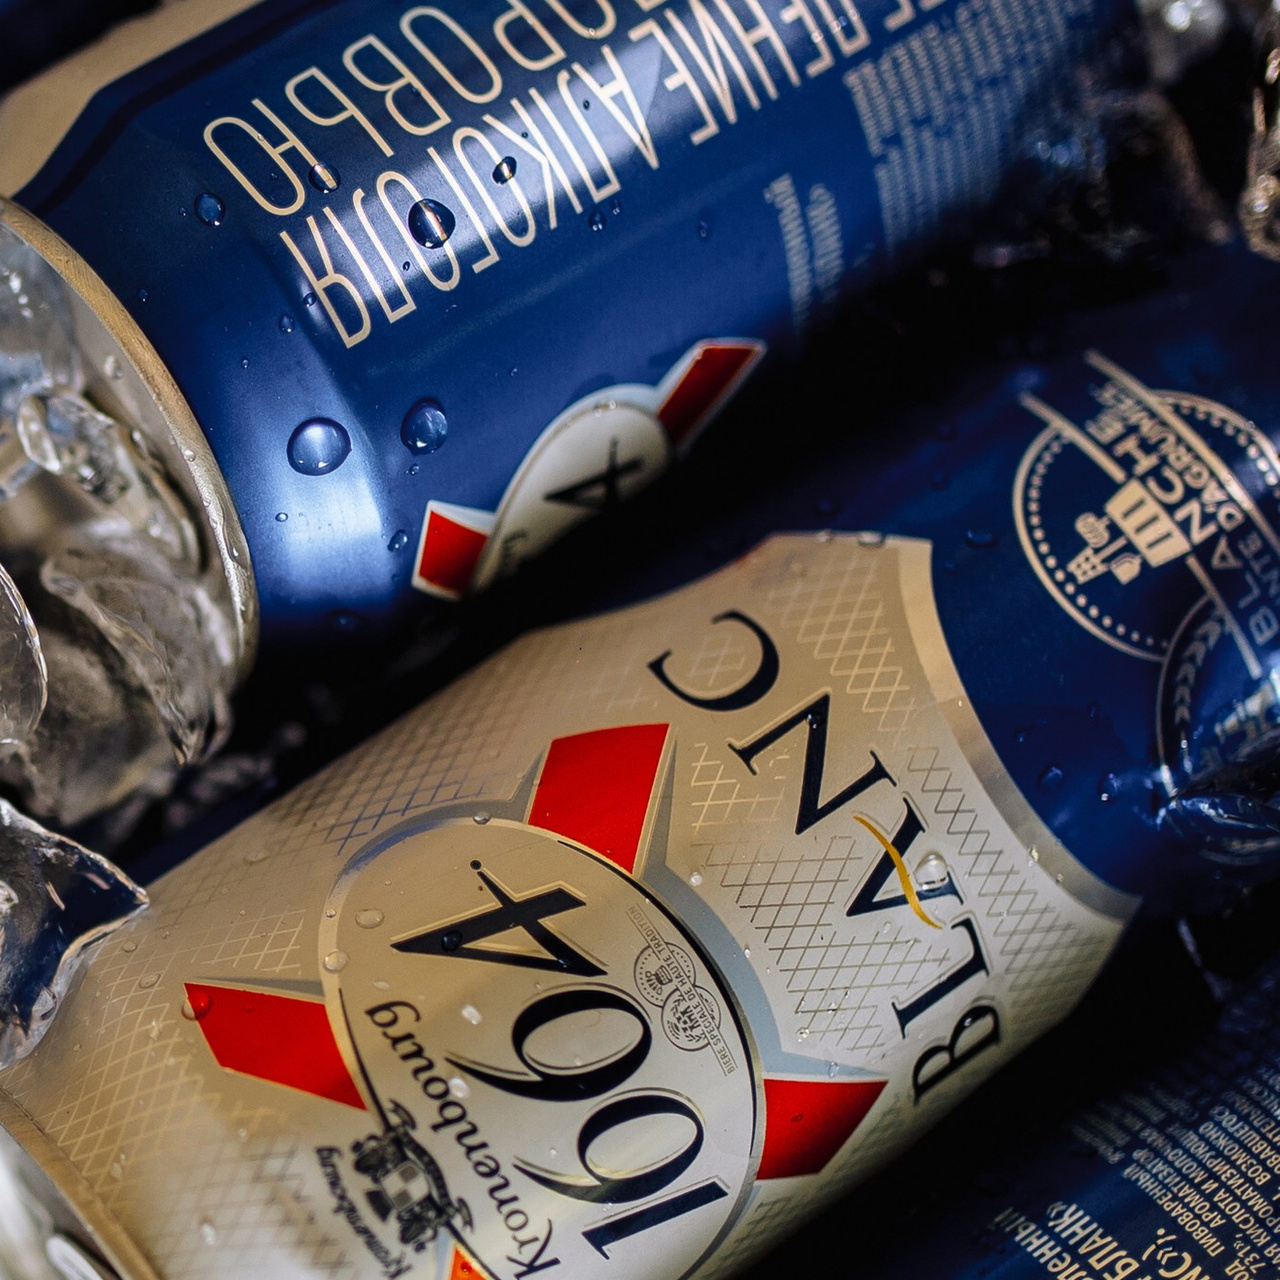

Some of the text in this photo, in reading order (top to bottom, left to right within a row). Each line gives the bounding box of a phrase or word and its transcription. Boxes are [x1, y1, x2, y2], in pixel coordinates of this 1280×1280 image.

[277, 43, 656, 348] АЛКОГОЛЯ
[1082, 406, 1280, 646] BLANCHE
[647, 616, 1001, 1104] BLANC
[627, 903, 736, 1074] BIERE SPECIALE DE HAUTE TRADITION
[389, 860, 730, 1260] 1664
[1120, 1161, 1225, 1257] ПИВОВАРЕННЫЙ
[1130, 1145, 1226, 1227] АРОМАТИЗАТОР
[1196, 1119, 1271, 1186] ВОЗМОЖНО
[1200, 1177, 1219, 1194] И
[1211, 1187, 1271, 1248] КИСЛОТА
